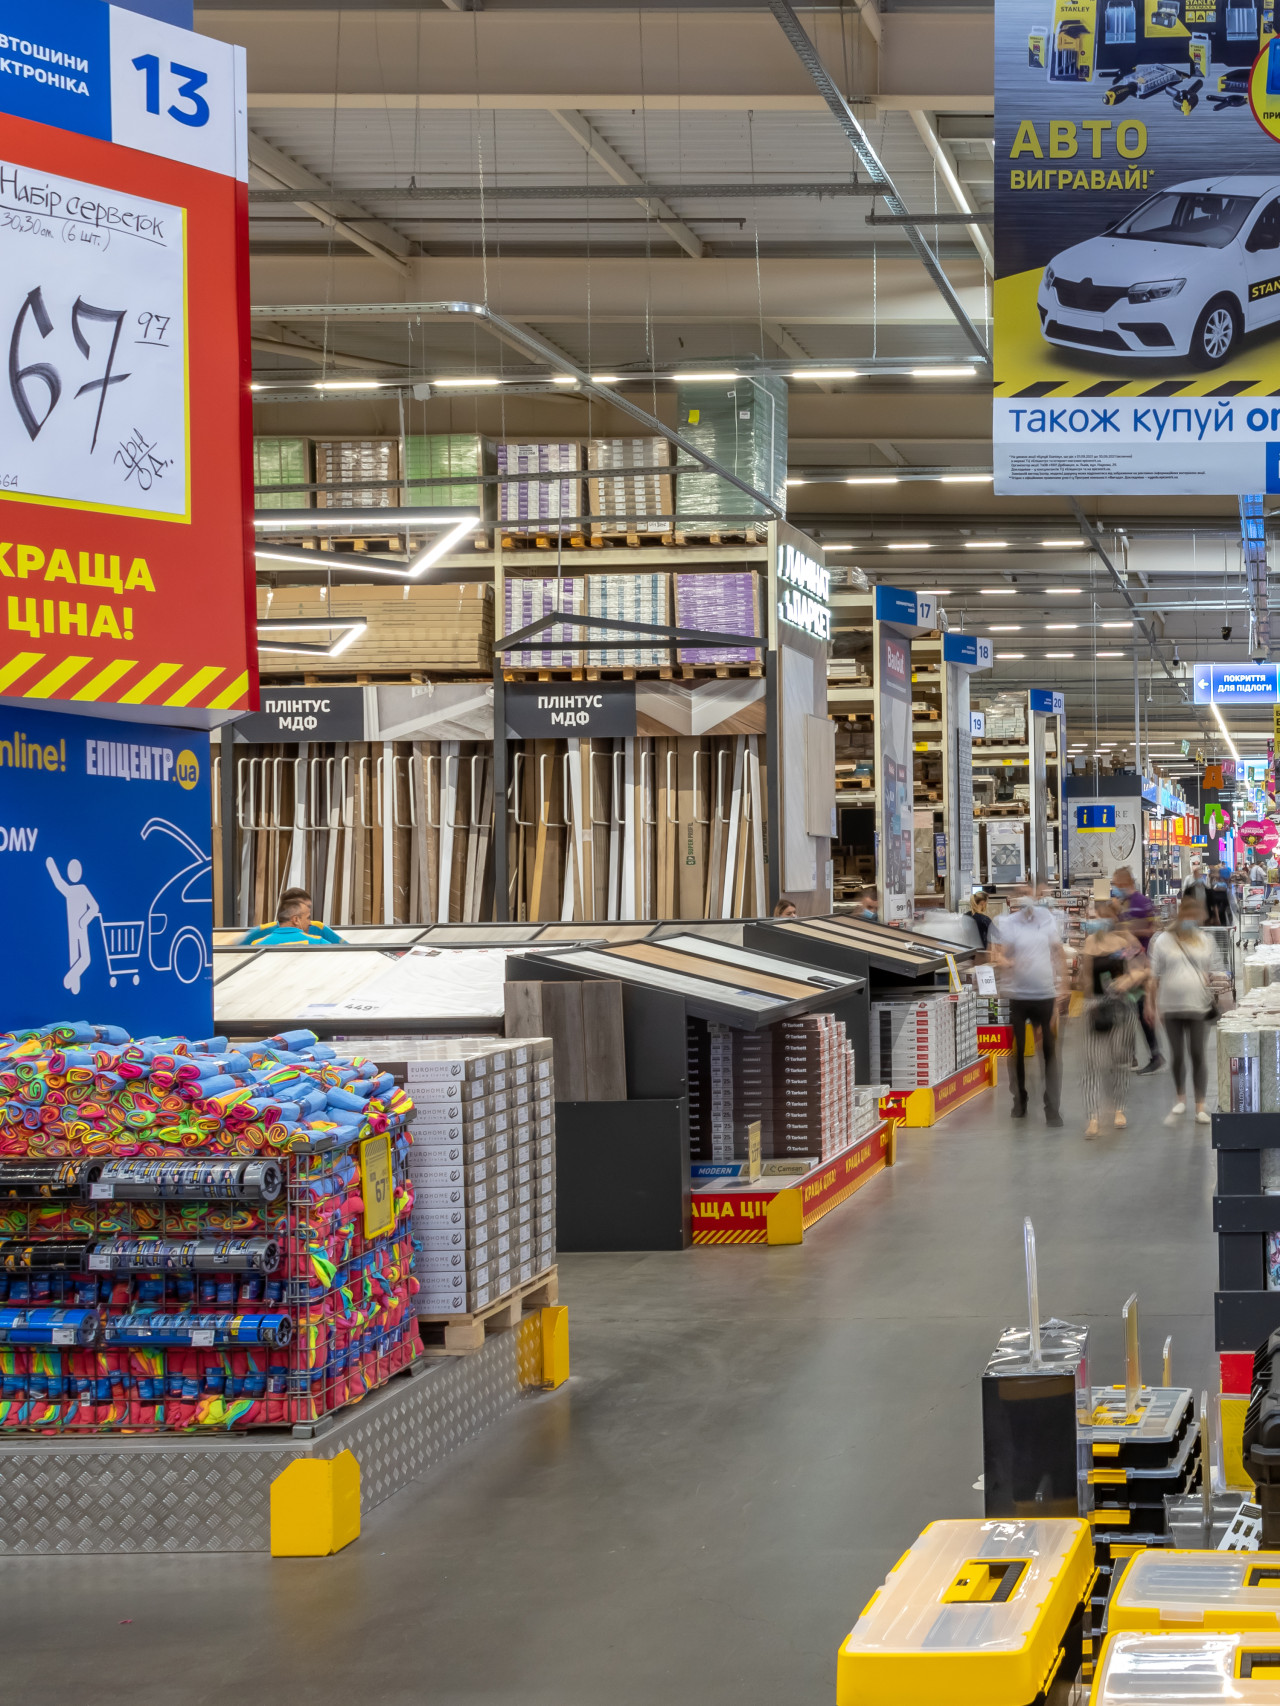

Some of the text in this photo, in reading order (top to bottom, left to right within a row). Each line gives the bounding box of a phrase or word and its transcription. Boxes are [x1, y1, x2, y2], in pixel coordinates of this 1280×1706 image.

[1060, 6, 1090, 14] STANLEY
[131, 53, 210, 128] 13
[1009, 119, 1149, 160] АВТО
[8, 286, 132, 455] 67
[1008, 408, 1121, 433] також
[1133, 401, 1234, 441] купуй
[8, 595, 134, 641] ЦІНА!
[919, 602, 931, 618] 17
[978, 645, 989, 659] 18
[1223, 674, 1266, 683] ПОКРИТТЯ
[1218, 684, 1272, 693] ДЛЯ ПІДЛОГИ
[265, 699, 331, 714] ПЛІНТУС
[537, 694, 603, 710] ПЛІНТУС
[1053, 698, 1062, 708] 20
[278, 717, 317, 731] МДФ
[550, 711, 590, 727] МДФ
[973, 718, 982, 730] 19
[375, 1179, 386, 1203] 67
